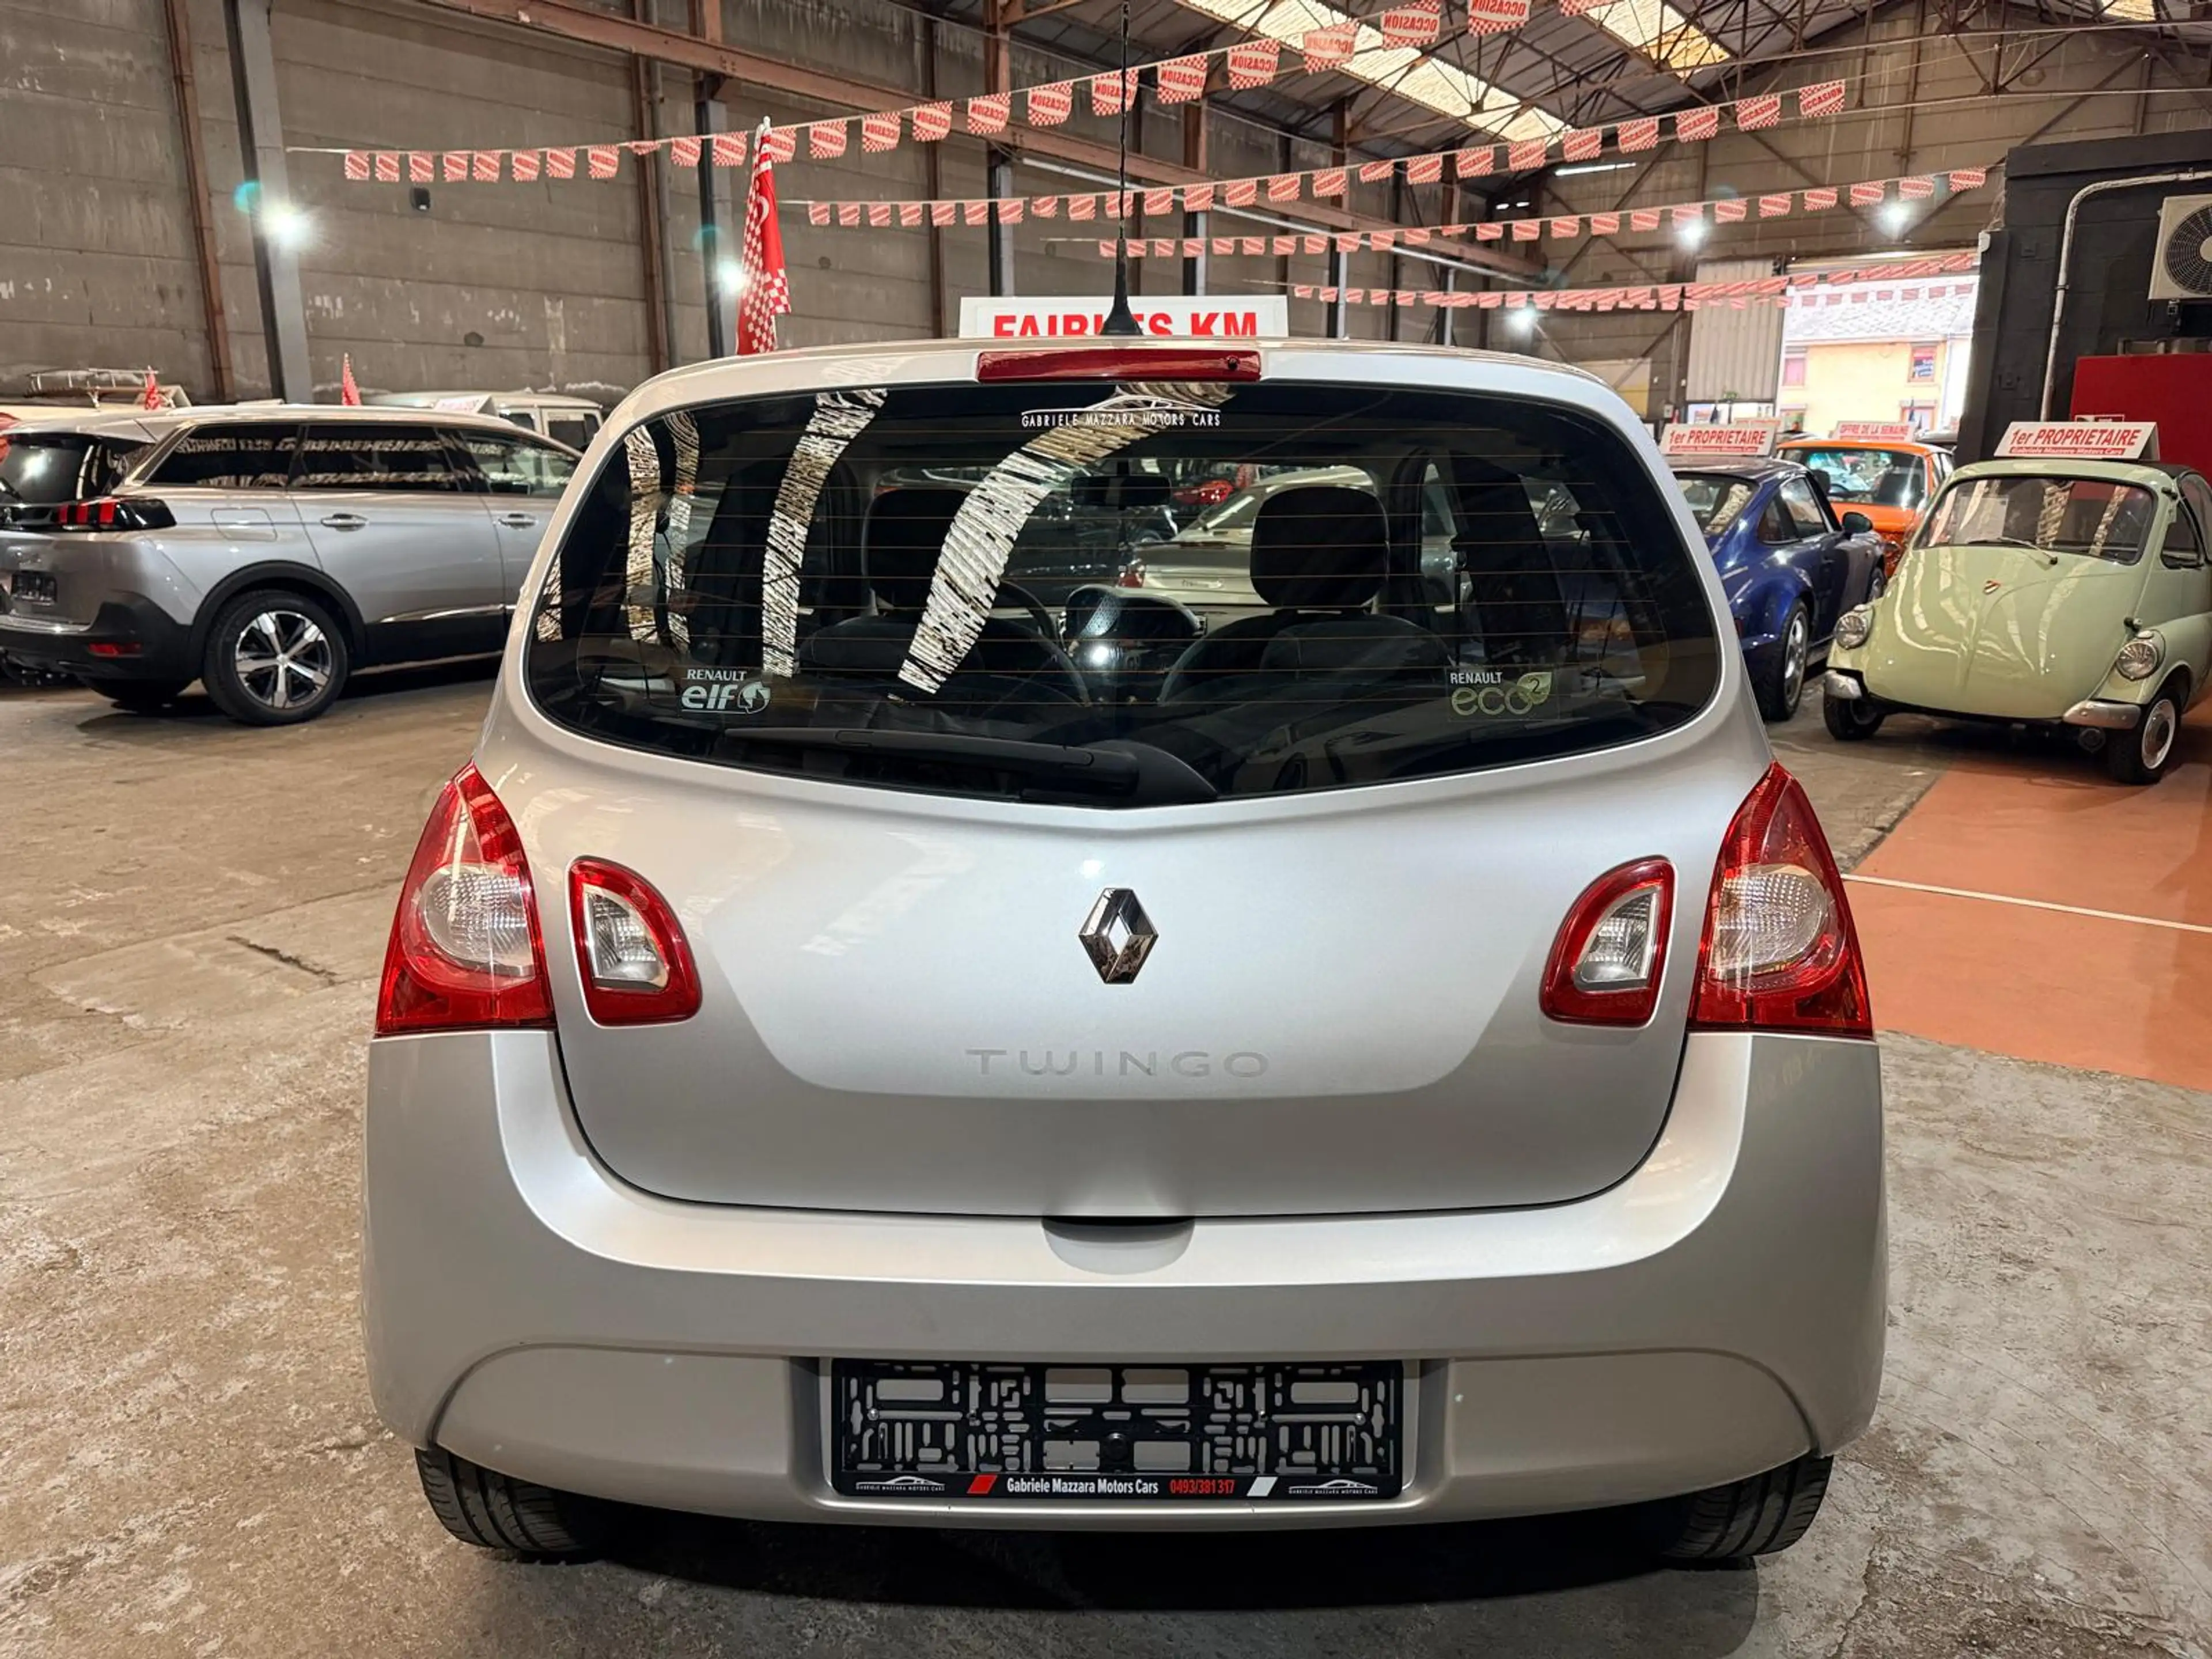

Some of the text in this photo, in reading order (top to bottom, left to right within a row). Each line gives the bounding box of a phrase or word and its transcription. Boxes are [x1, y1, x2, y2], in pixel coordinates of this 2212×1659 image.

[994, 312, 1257, 336] FAIBS KM
[1021, 412, 1221, 428] GABRIELE MAZZARA MOTORS CARS
[1669, 430, 1767, 445] 1er PROPRIETAIRE
[2010, 429, 2142, 446] 1er PROPRIETAIRE
[687, 668, 748, 681] RENAULT
[1449, 671, 1503, 684] RENAULT
[681, 684, 738, 710] elf
[965, 1049, 1268, 1078] TWINGO
[1007, 1477, 1050, 1493] Gabriele
[1052, 1478, 1095, 1493] Mazzara
[1097, 1478, 1133, 1494] Motors
[1135, 1479, 1159, 1494] Cars
